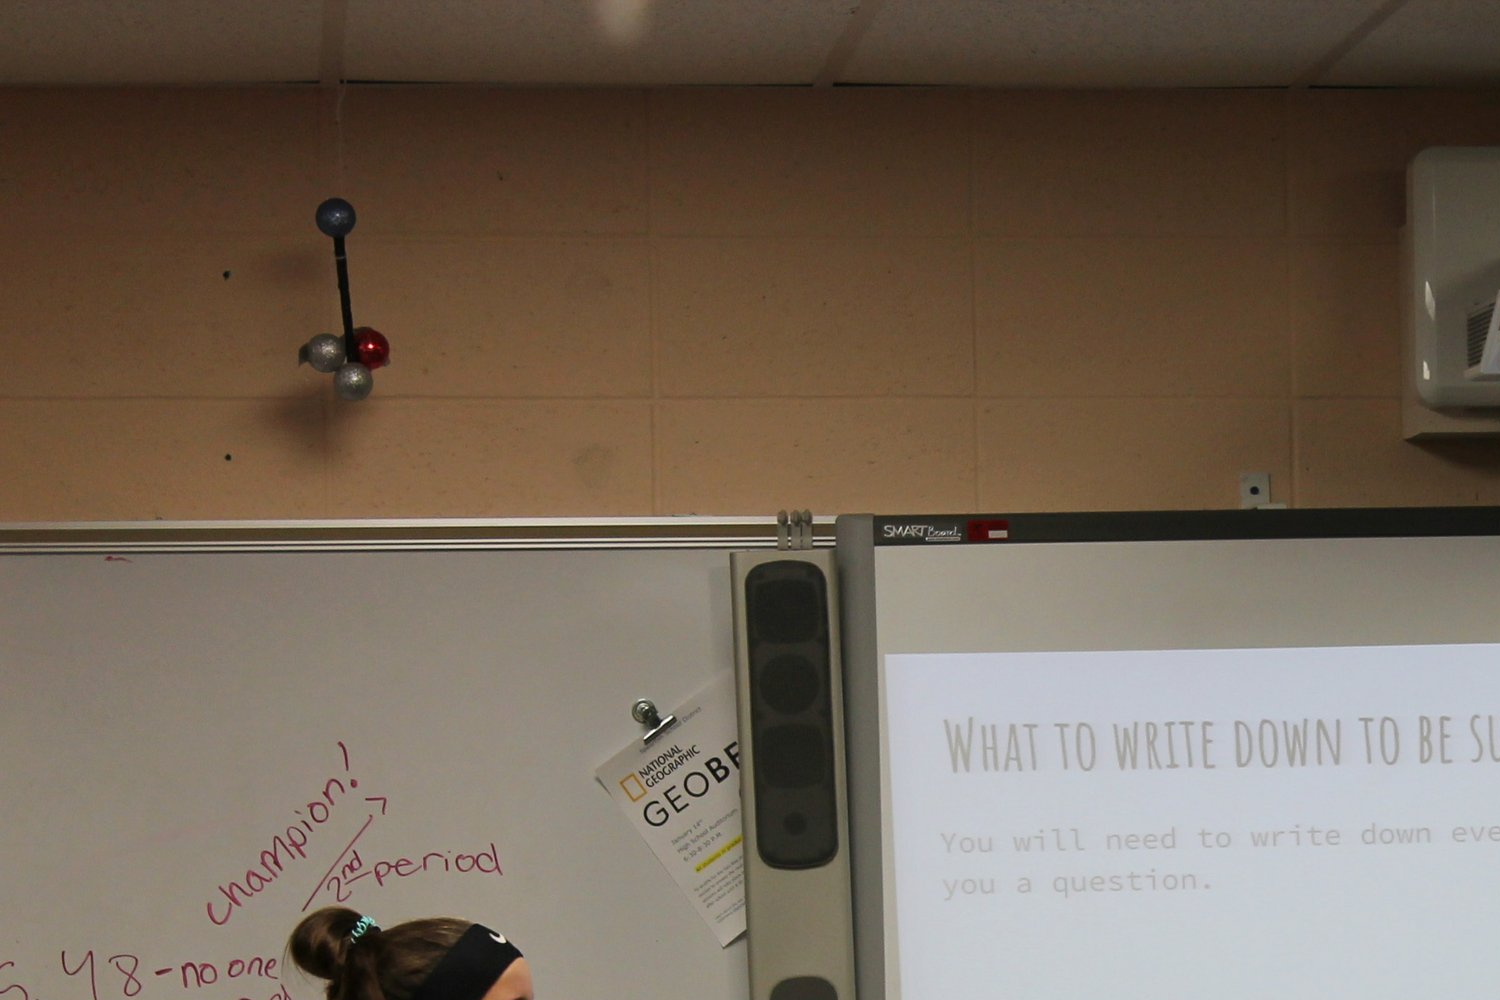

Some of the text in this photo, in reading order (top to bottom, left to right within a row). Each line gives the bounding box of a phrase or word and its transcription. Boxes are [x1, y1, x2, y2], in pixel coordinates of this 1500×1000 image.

[883, 524, 927, 538] SMART
[637, 744, 683, 778] NATIONAL
[1053, 721, 1097, 771] TO
[1112, 719, 1216, 771] WRITE
[1234, 717, 1343, 768] DOWN
[1358, 716, 1401, 766] TO
[1418, 714, 1454, 765] BE
[644, 744, 701, 788] GEOGRAPHIC
[206, 740, 359, 926] champion!
[941, 830, 994, 856] You
[1012, 827, 1086, 854] will
[1105, 826, 1176, 852] need
[1198, 827, 1232, 850] to
[1250, 823, 1341, 849] write
[1360, 821, 1432, 847] down
[327, 842, 504, 903] 2nd period
[941, 868, 1213, 902] you a question.
